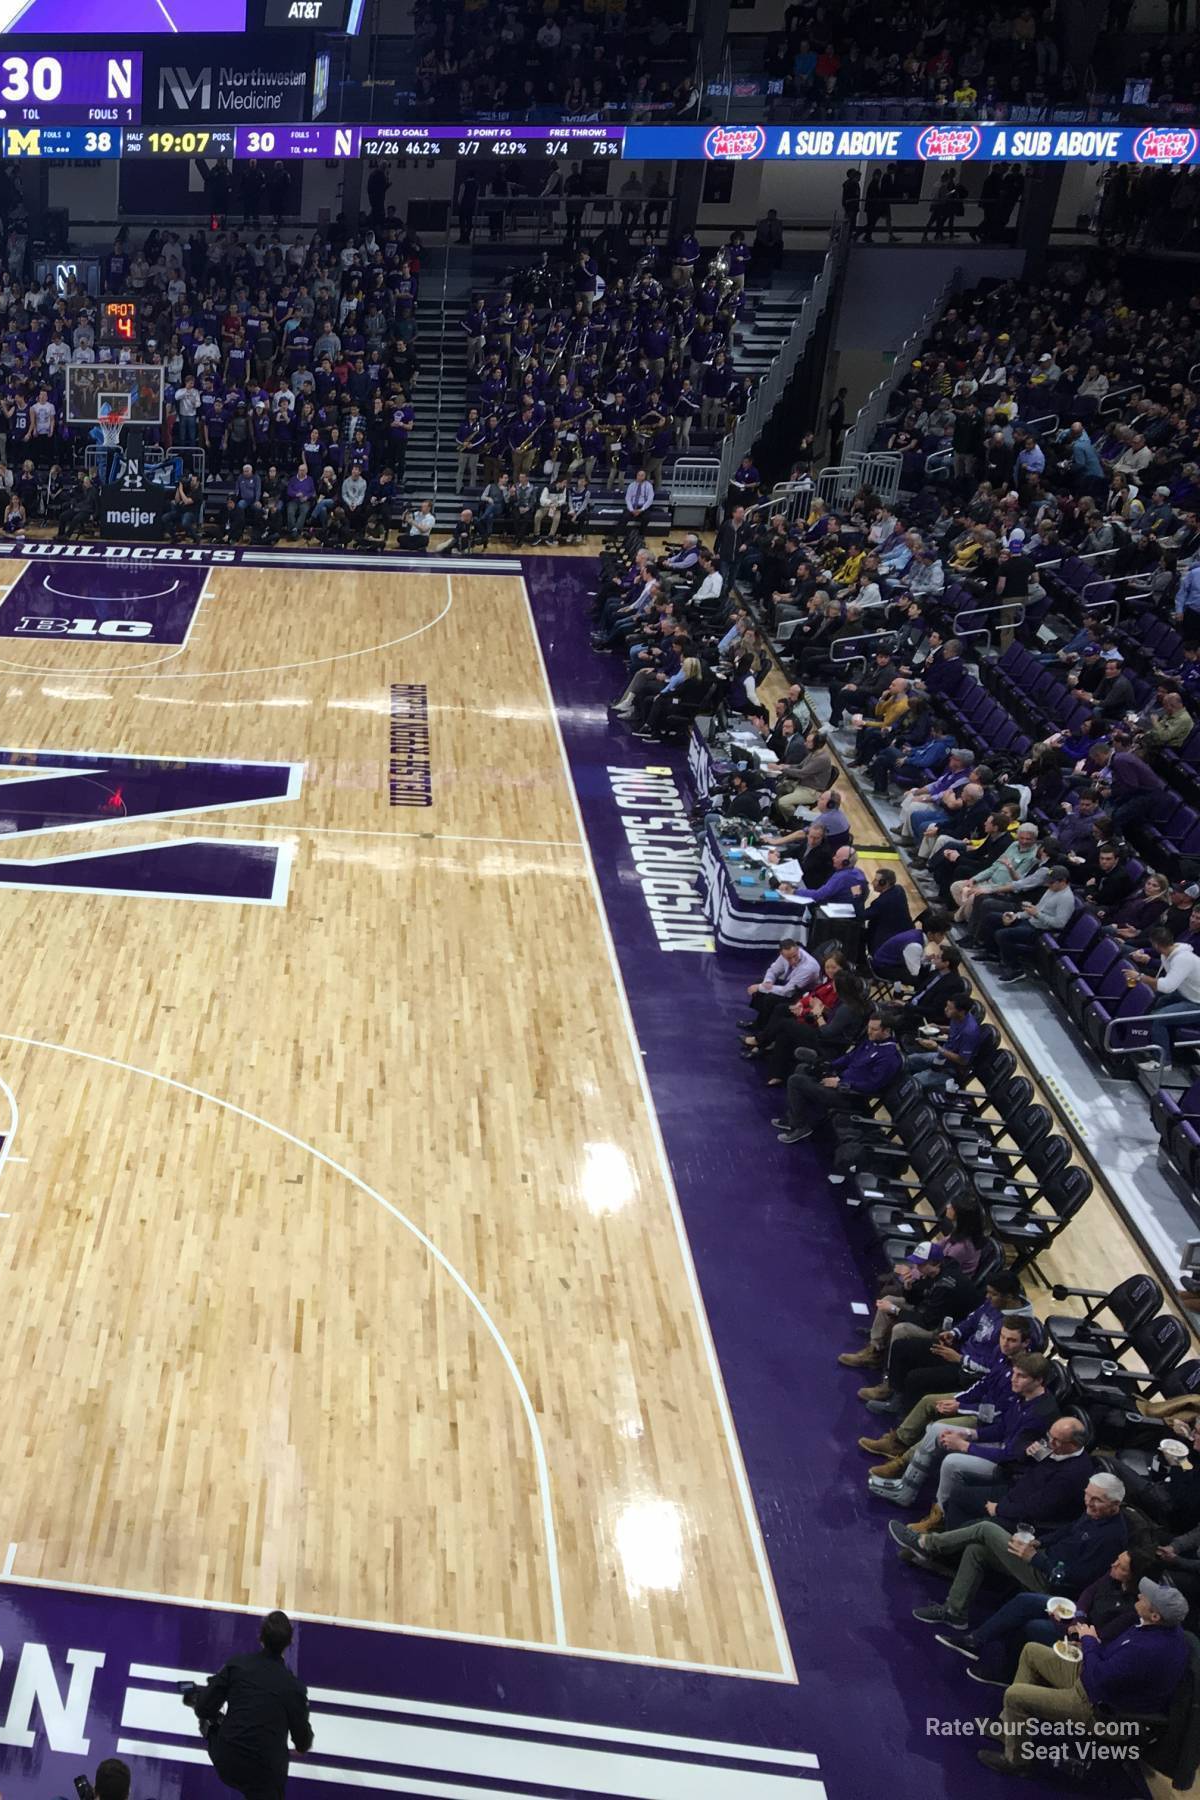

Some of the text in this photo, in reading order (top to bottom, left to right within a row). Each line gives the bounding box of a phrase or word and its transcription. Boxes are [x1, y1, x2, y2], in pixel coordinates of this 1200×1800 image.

[288, 2, 322, 19] AT&T
[1, 56, 63, 101] 30
[107, 59, 132, 98] N
[219, 67, 307, 86] Northwestern
[22, 109, 40, 120] TOL
[89, 109, 133, 121] FOULS 1
[126, 133, 143, 141] HALF
[212, 133, 232, 141] POSS.
[378, 128, 428, 136] FIELD GOALS
[7, 129, 41, 155] M
[85, 132, 111, 152] 38
[127, 144, 141, 152] 2ND
[148, 132, 209, 153] 19:07
[247, 132, 275, 153] 30
[334, 129, 352, 156] N
[365, 142, 440, 154] 12/26 46.2%
[458, 142, 527, 154] 3/7 42.9%
[545, 142, 618, 154] 3/4 75%
[777, 131, 901, 155] A SUB ABOVE
[992, 132, 1123, 156] A SUB ABOVE
[107, 303, 135, 316] 19:07
[118, 318, 132, 337] 4
[128, 459, 139, 475] N
[106, 507, 156, 528] meijer
[21, 543, 236, 562] WILDCATS
[390, 721, 433, 807] WELSH-RYAN
